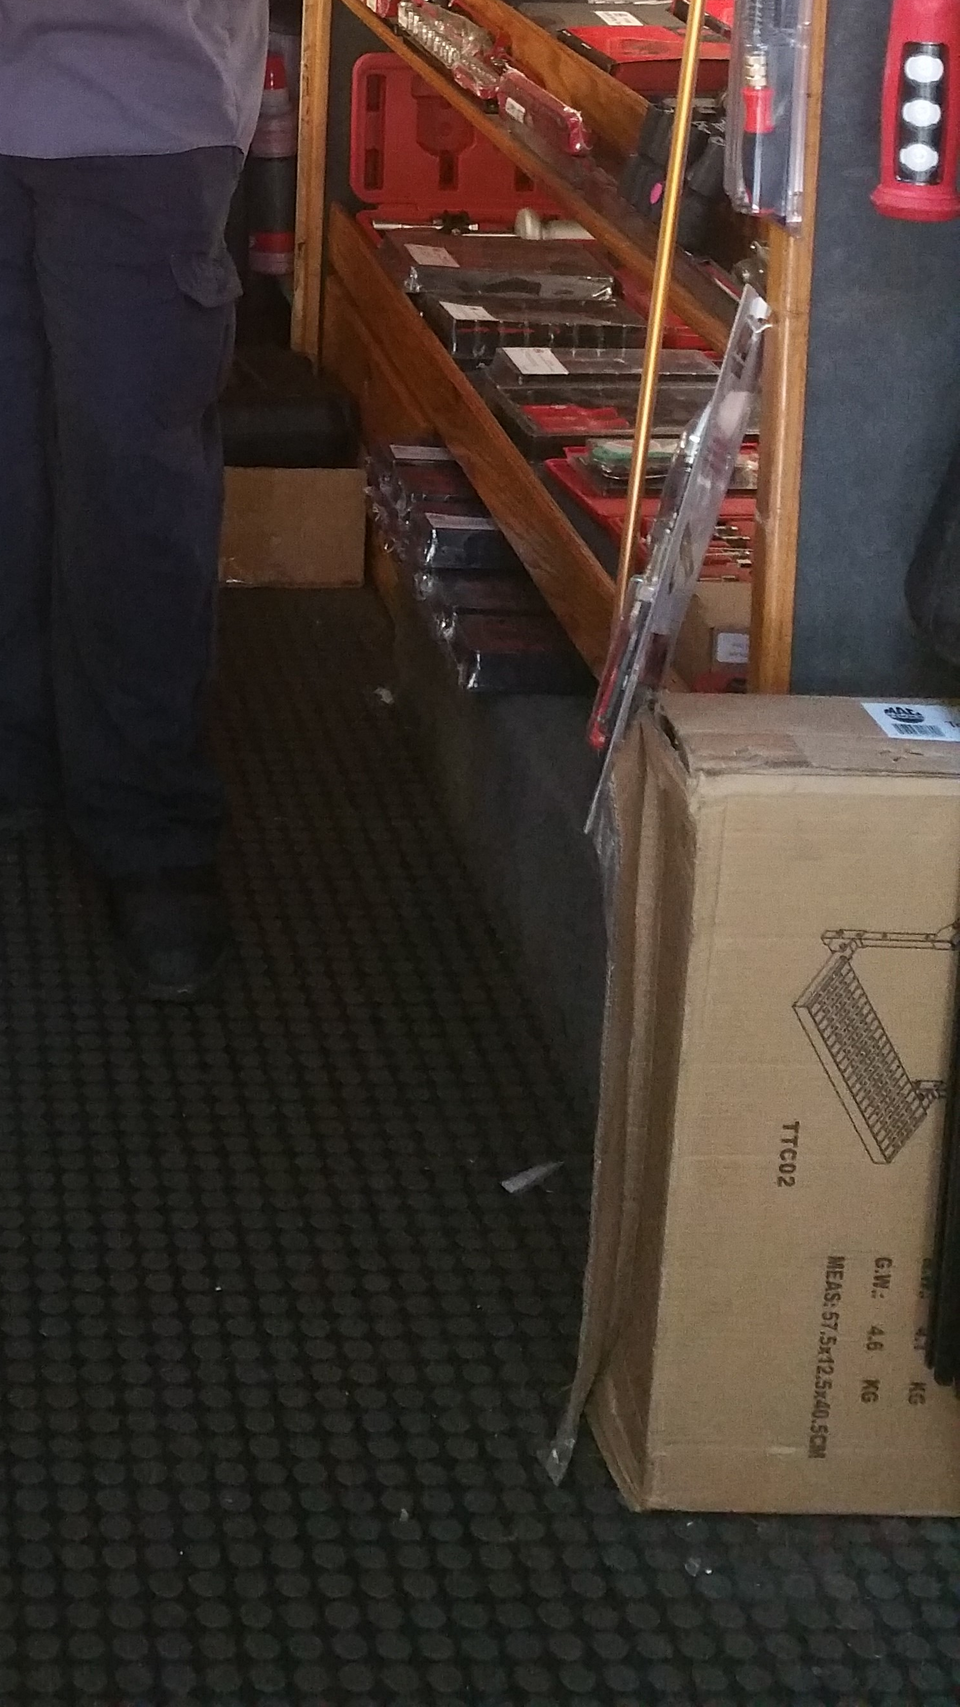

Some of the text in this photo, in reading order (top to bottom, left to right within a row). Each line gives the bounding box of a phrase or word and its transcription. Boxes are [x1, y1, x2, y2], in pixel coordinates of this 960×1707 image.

[777, 1121, 801, 1188] TTC02
[808, 1255, 846, 1459] MEAS: 57.5x12.5x40.5CM
[860, 1256, 894, 1405] G.W.: 4.6 KG
[907, 1381, 927, 1406] KG
